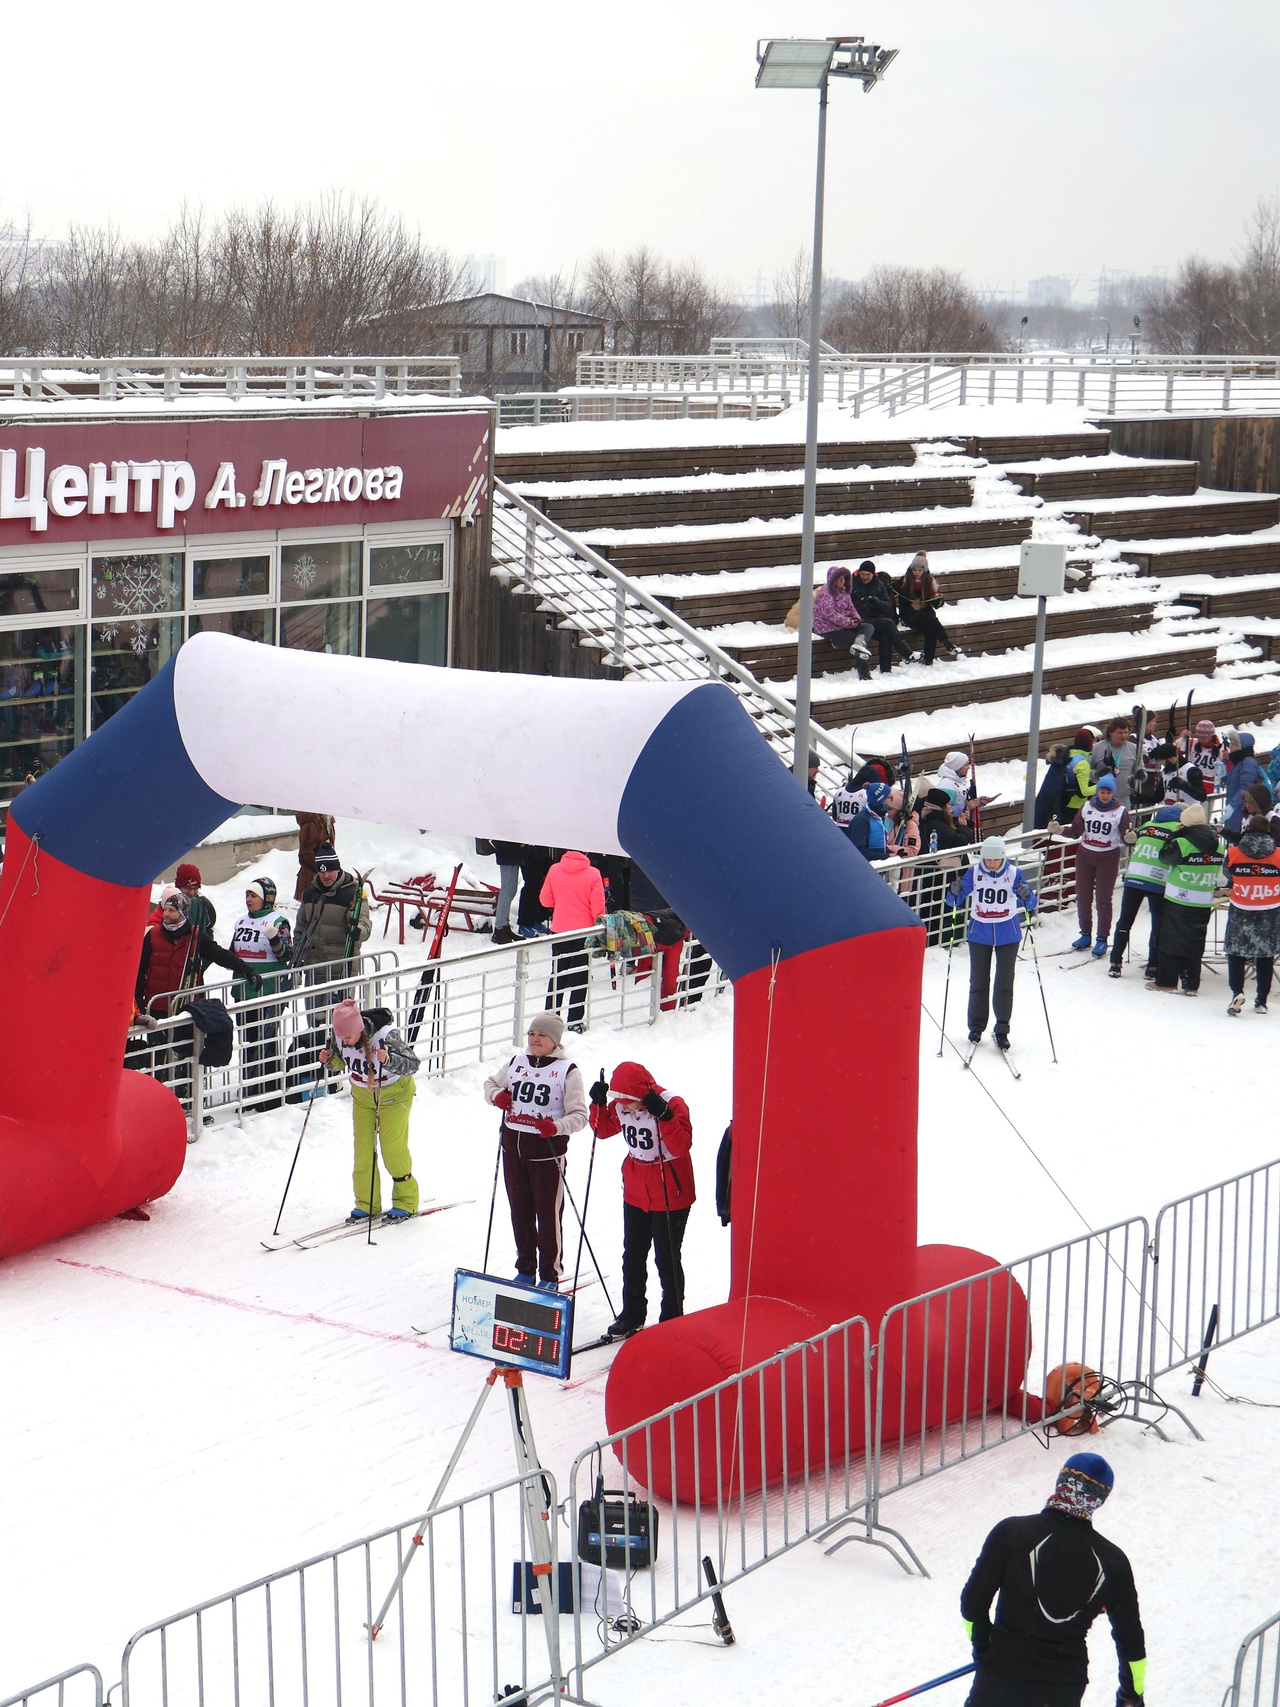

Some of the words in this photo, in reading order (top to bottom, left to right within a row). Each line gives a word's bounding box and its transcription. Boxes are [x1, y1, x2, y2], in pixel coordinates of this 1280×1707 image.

[204, 462, 247, 509] А.
[253, 458, 403, 507] Легкова
[837, 801, 860, 815] 186
[1086, 819, 1112, 836] 199
[1153, 829, 1170, 839] Sport
[1188, 855, 1204, 863] Arta
[1235, 866, 1251, 874] Arta
[976, 888, 1008, 905] 190
[1233, 882, 1280, 900] СУДЬЯ
[234, 927, 261, 943] 251
[511, 1080, 551, 1106] 193
[621, 1123, 654, 1151] 183
[462, 1295, 494, 1309] НОМЕР:
[494, 1325, 558, 1359] 02:11
